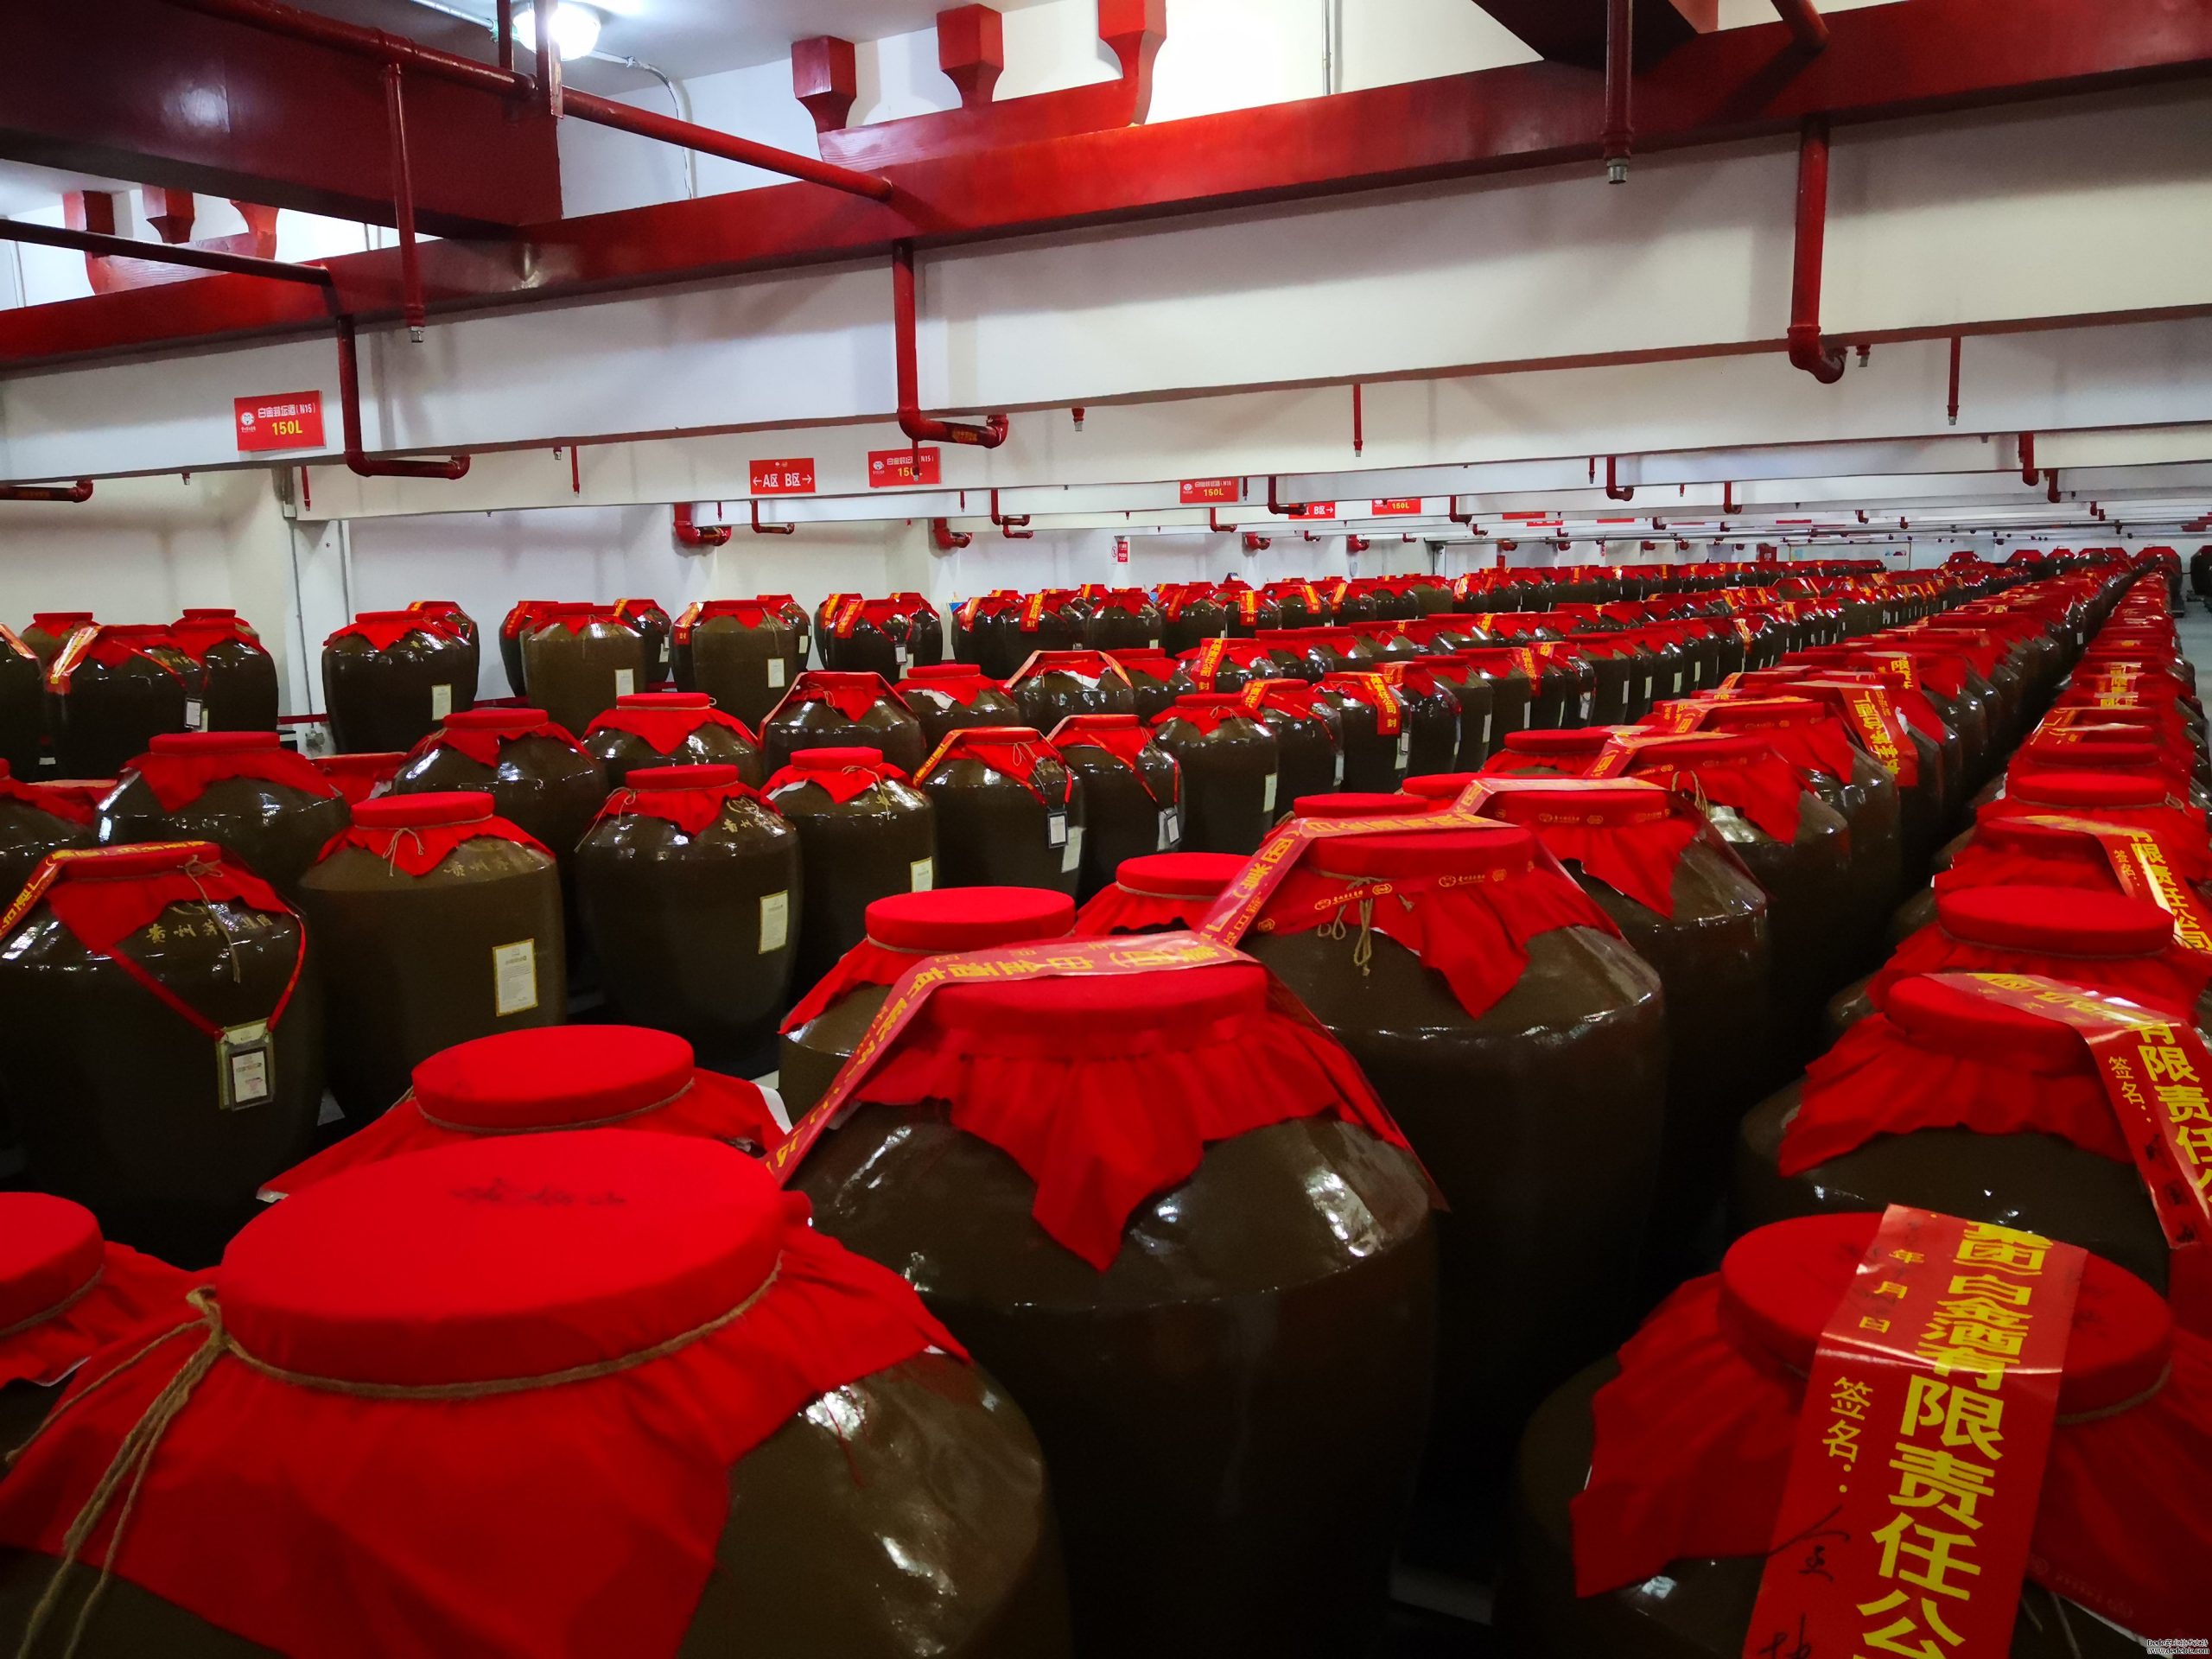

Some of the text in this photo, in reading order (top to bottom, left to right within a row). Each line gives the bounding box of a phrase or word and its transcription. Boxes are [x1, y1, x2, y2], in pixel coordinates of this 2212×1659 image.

[272, 420, 302, 435] 150L
[763, 473, 802, 487] A区 B区
[1821, 1376, 1873, 1494] 签名：
